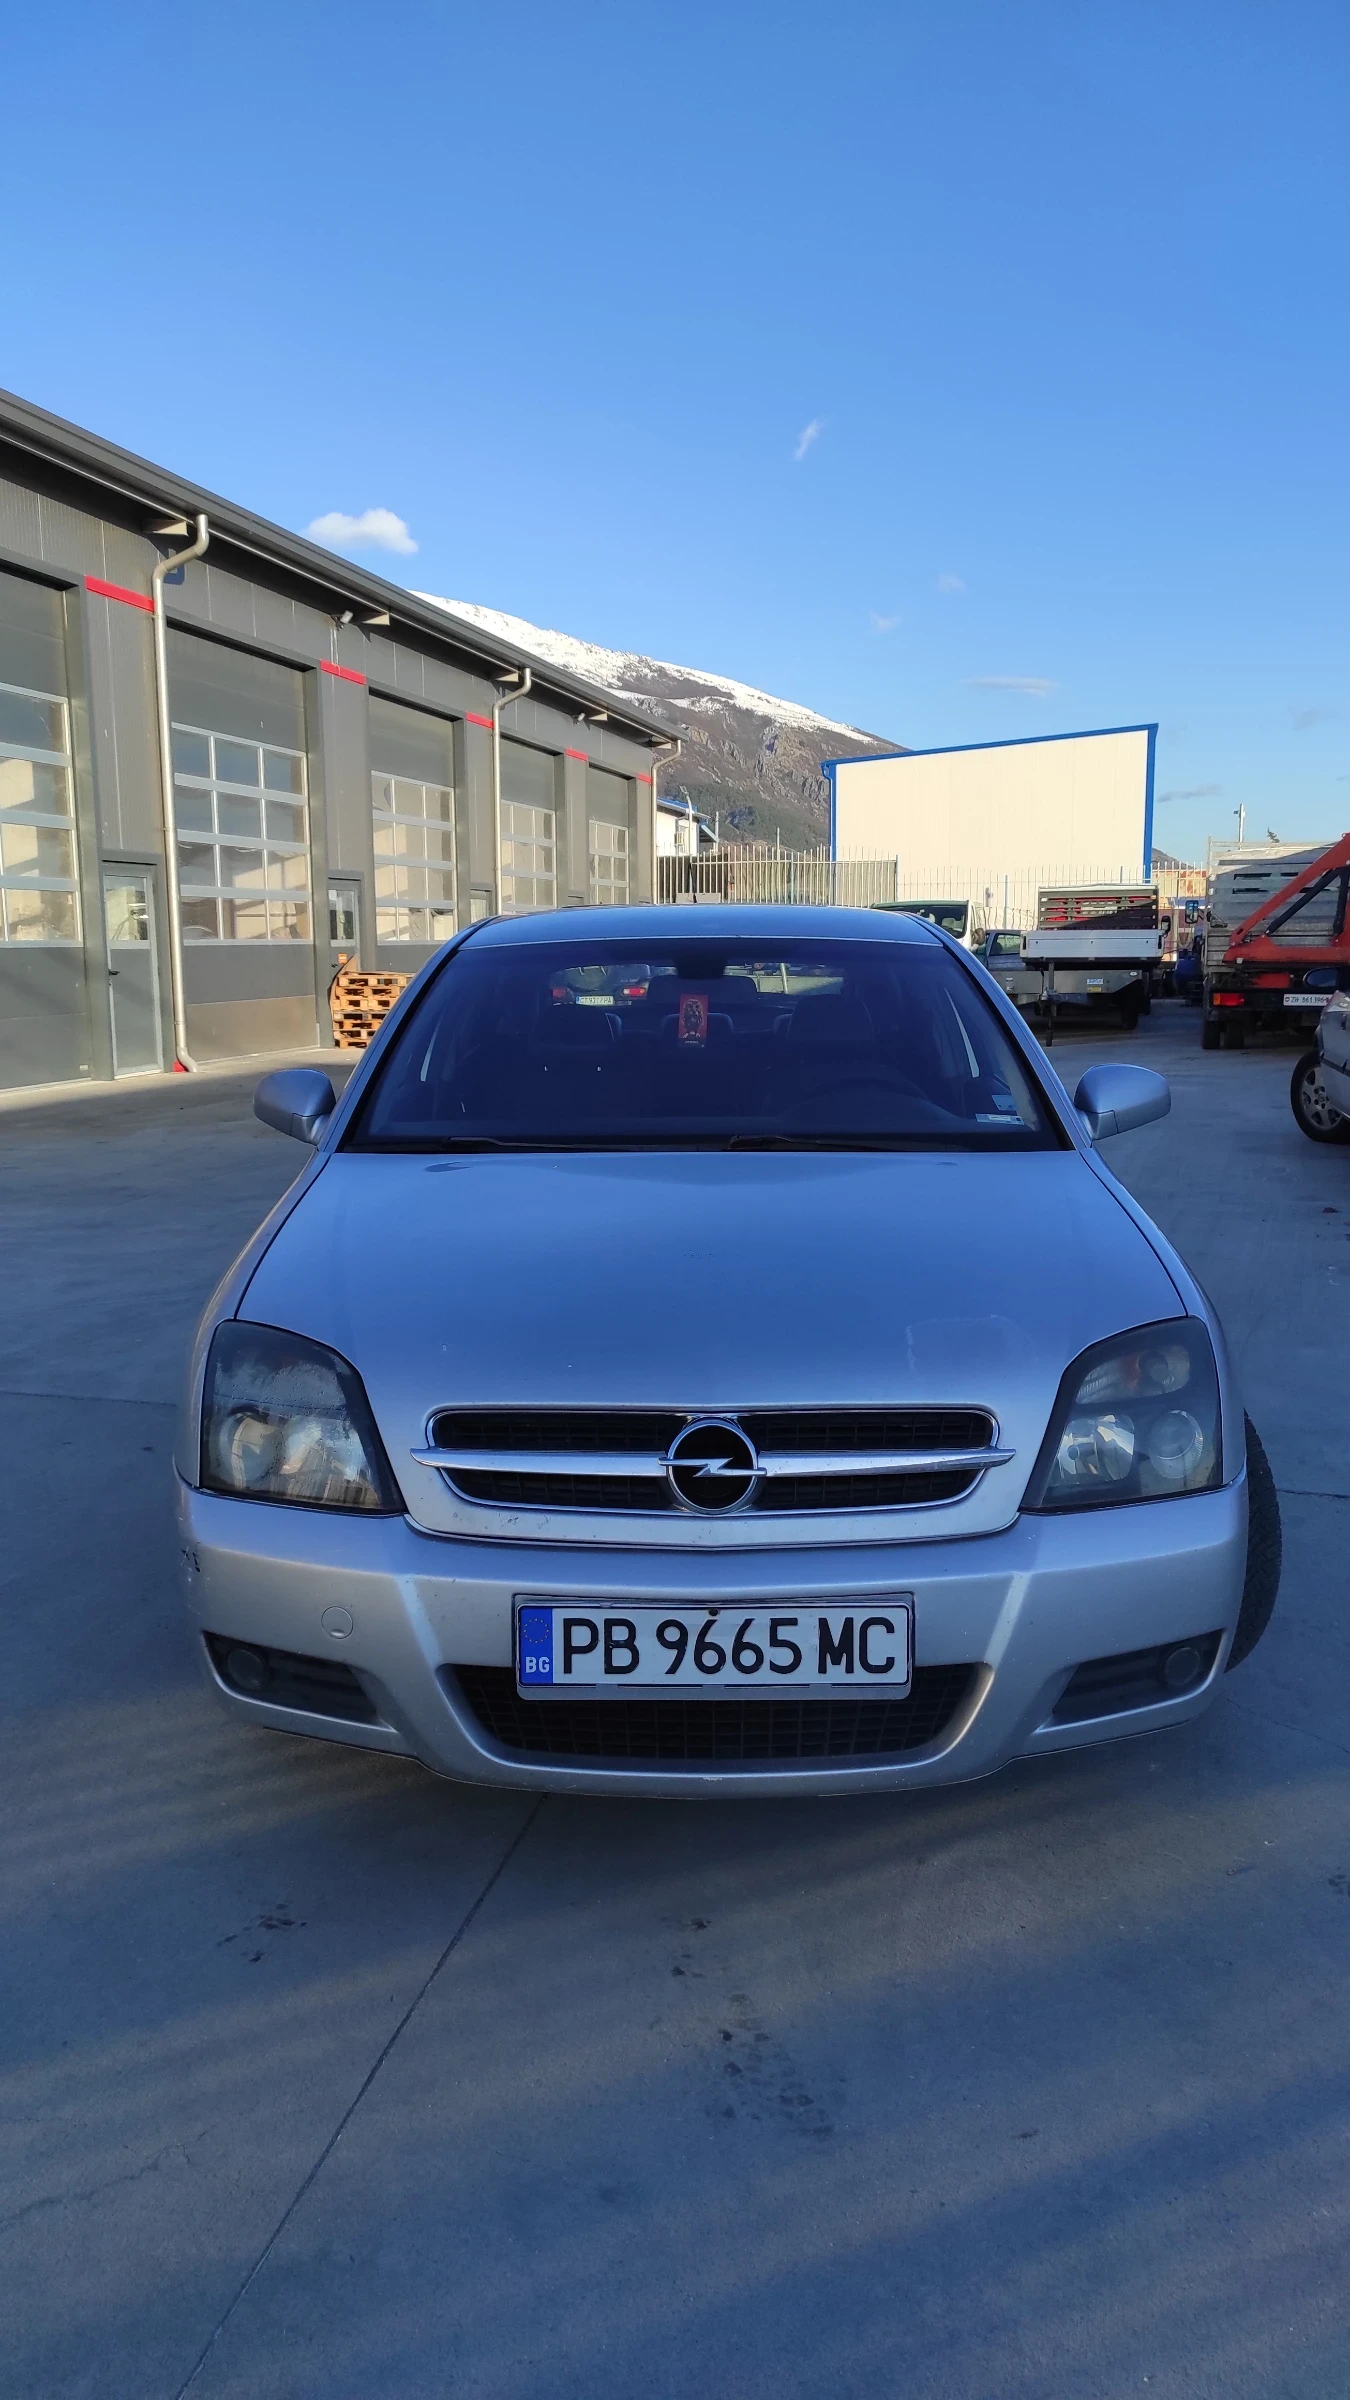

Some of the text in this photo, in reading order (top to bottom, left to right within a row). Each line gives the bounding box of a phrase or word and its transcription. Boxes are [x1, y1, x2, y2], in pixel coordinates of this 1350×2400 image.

[562, 1616, 895, 1675] PB 9665 MC
[525, 1656, 550, 1674] BG
